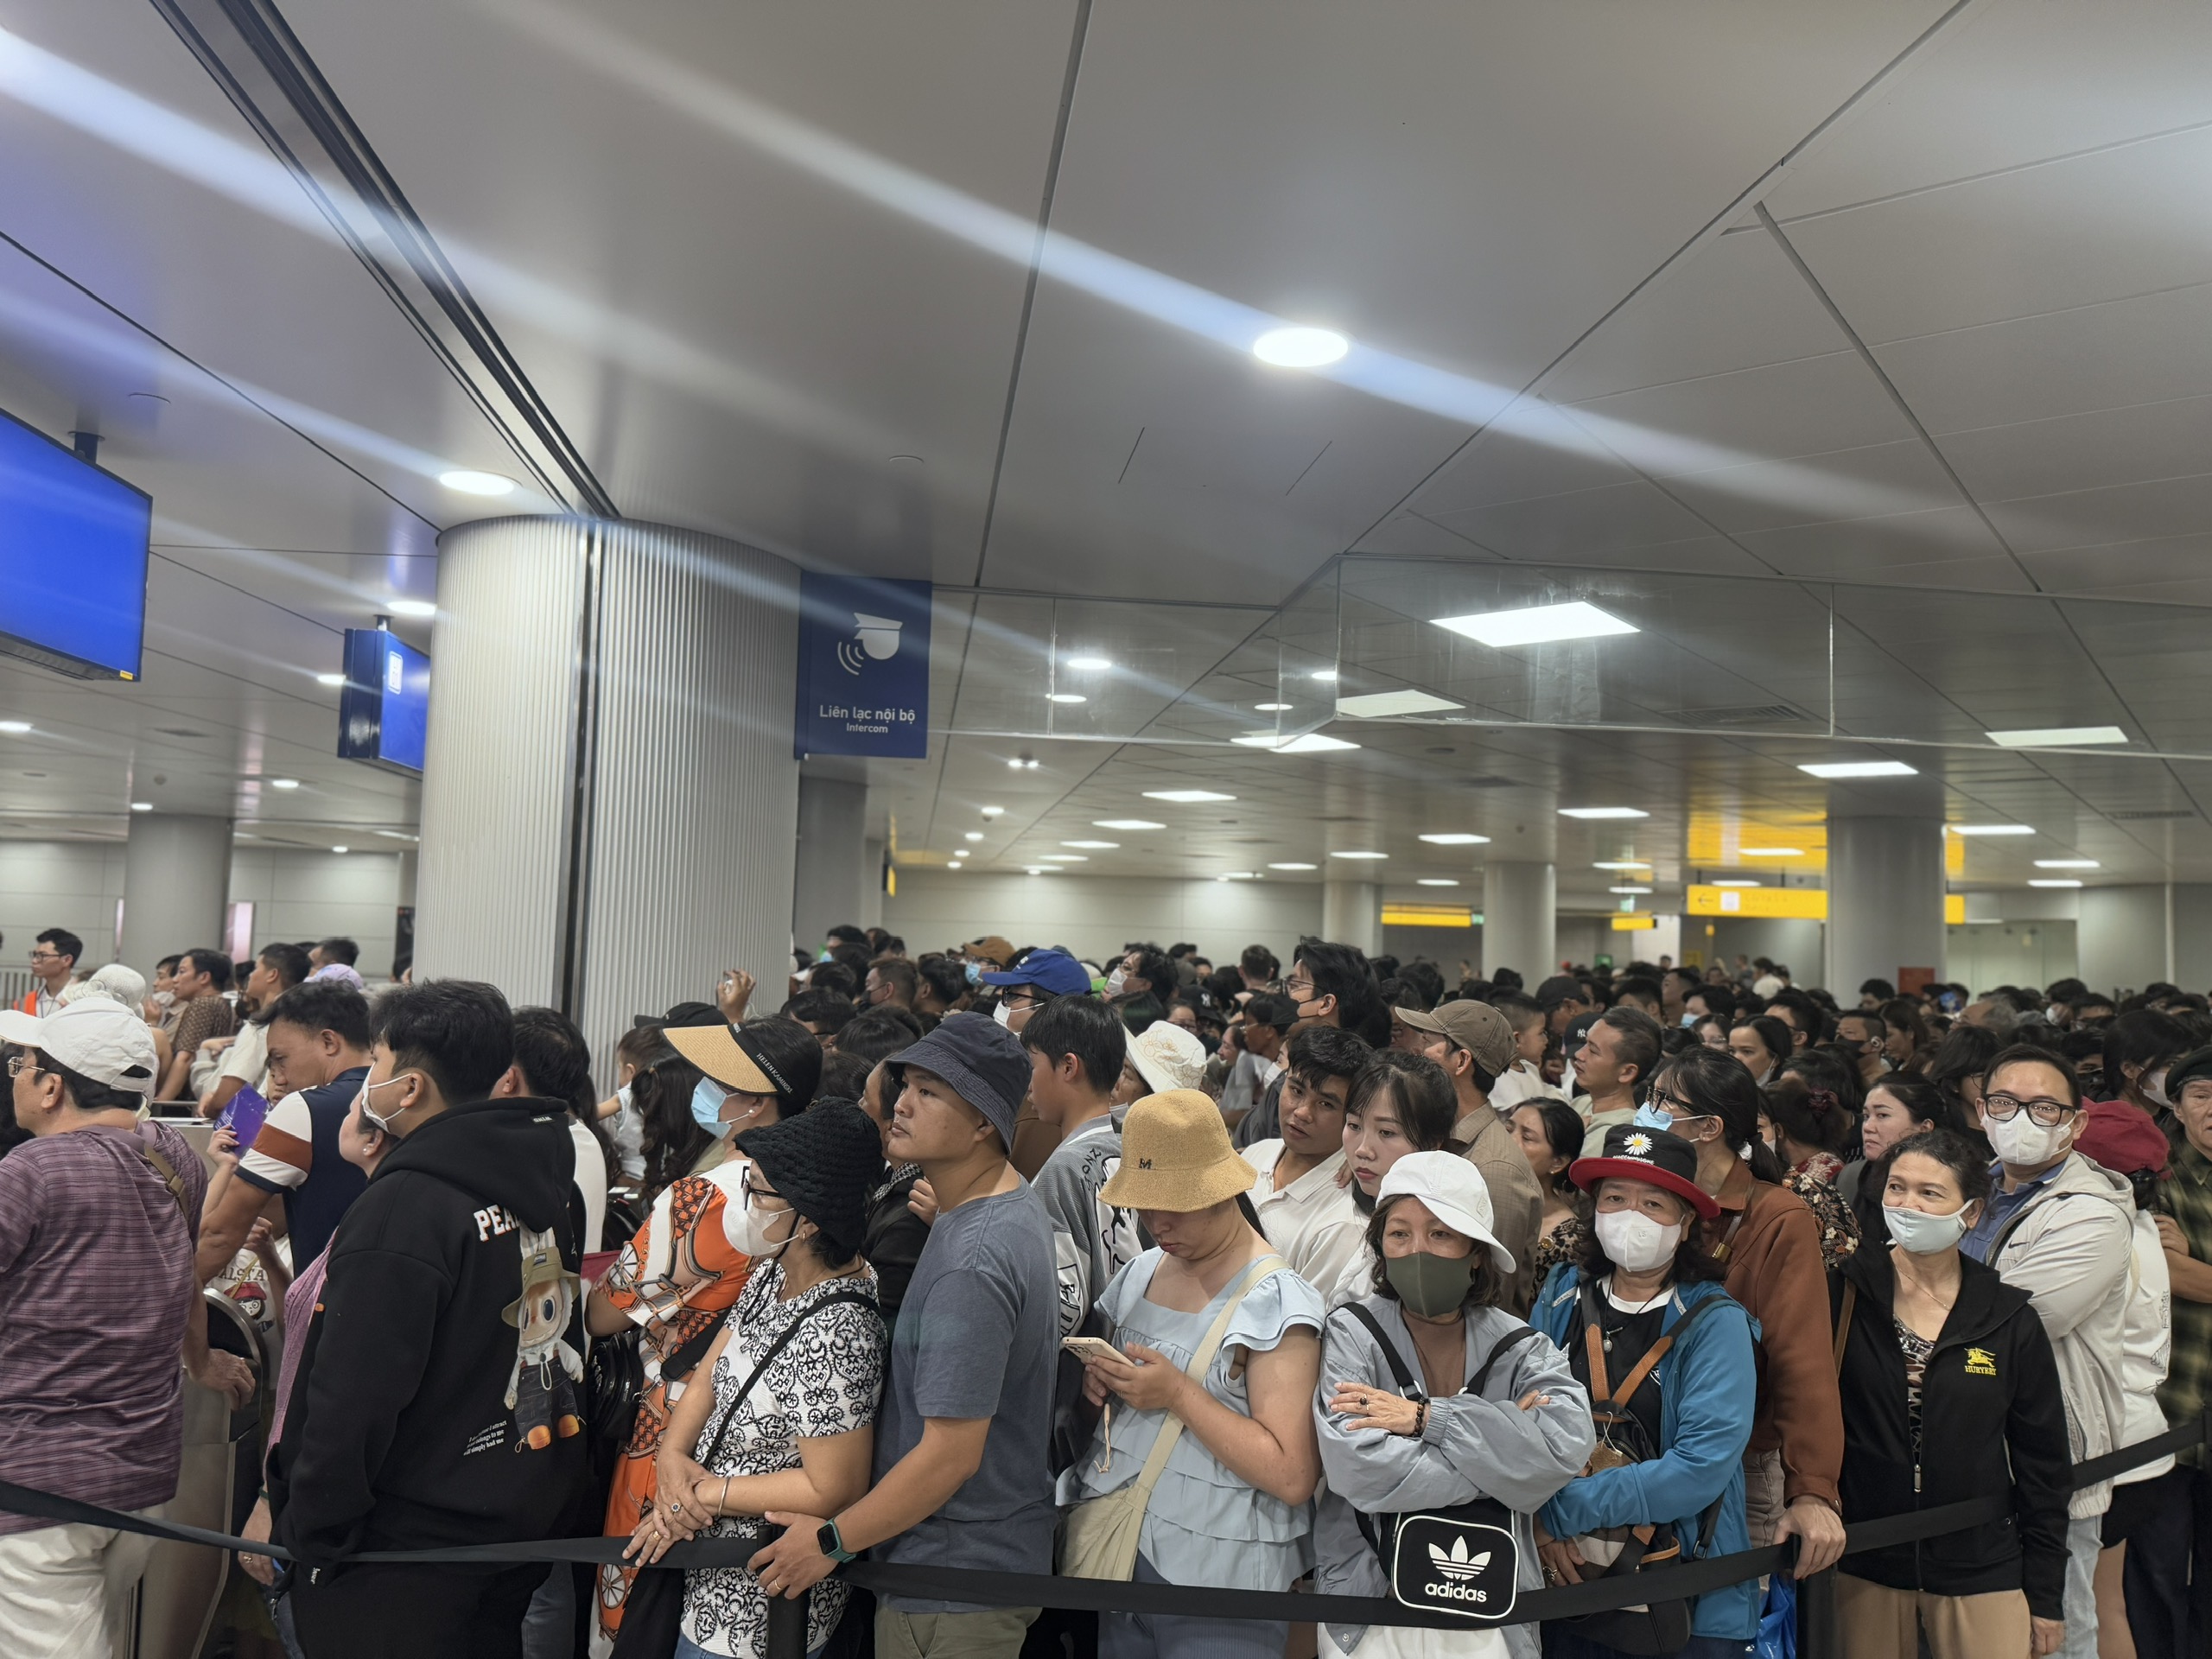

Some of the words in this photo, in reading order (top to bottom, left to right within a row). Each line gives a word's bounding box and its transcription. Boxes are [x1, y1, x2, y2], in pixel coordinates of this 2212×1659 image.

[819, 705, 849, 719] Liên
[853, 706, 872, 722] lạc
[875, 707, 895, 723] nội
[899, 708, 916, 724] bộ
[846, 722, 888, 734] Intercom
[756, 1052, 774, 1071] HELEN
[1424, 1581, 1487, 1603] adidas
